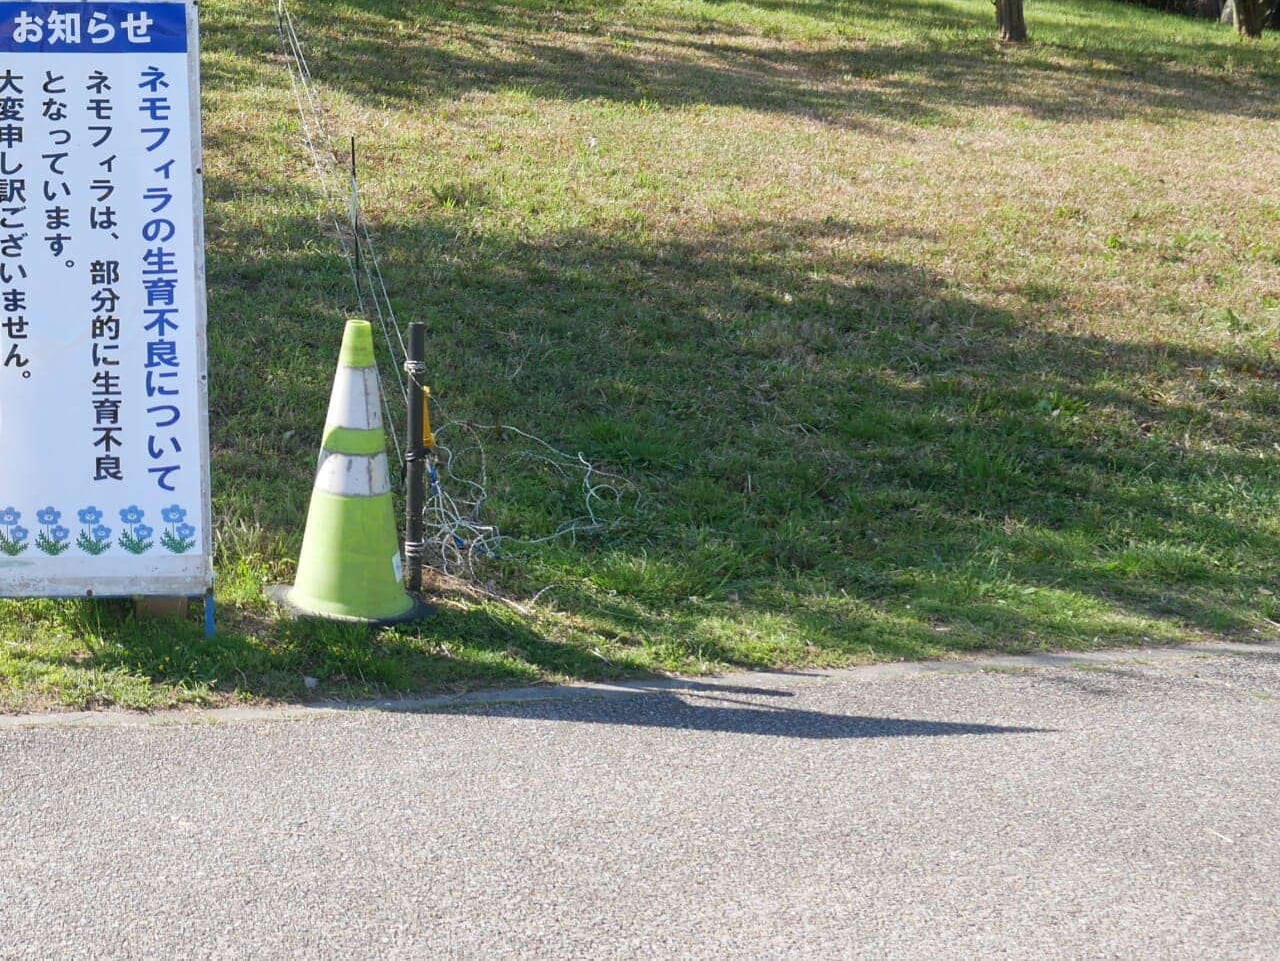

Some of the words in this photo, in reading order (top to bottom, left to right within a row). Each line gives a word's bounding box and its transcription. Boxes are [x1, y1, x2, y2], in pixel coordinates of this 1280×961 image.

[12, 10, 154, 45] お知らせ
[41, 70, 75, 269] となっています。
[86, 70, 124, 481] ネモフィラは、部分的に生育不良
[138, 66, 182, 492] ネモフィラの生育不良について
